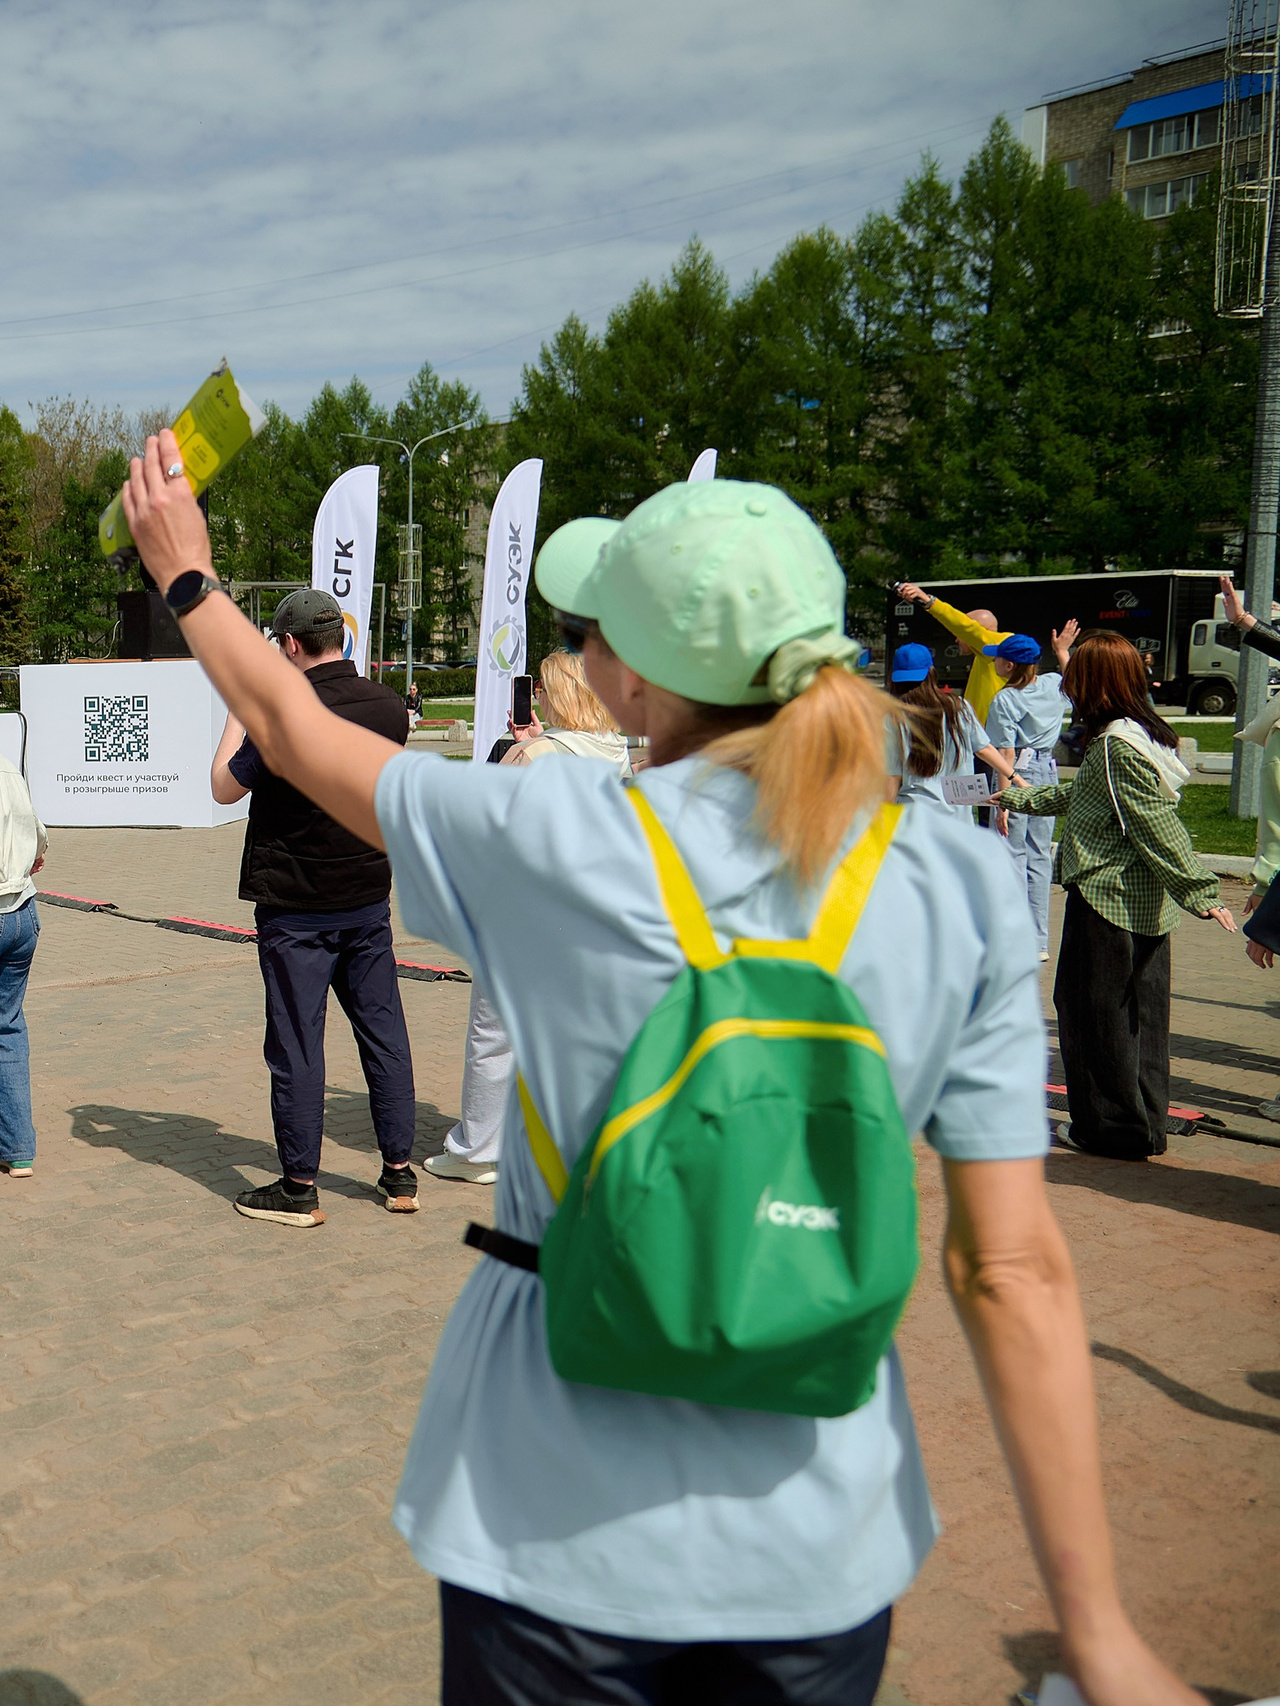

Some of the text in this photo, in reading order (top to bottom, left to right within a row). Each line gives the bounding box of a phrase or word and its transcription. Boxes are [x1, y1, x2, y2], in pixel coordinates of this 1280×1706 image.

[332, 537, 354, 598] СГК
[507, 521, 524, 605] СУЭК
[56, 773, 95, 783] Пройди
[97, 774, 123, 782] квест
[135, 773, 179, 783] участвуй
[72, 786, 130, 795] розыгрыше
[132, 786, 168, 794] призов
